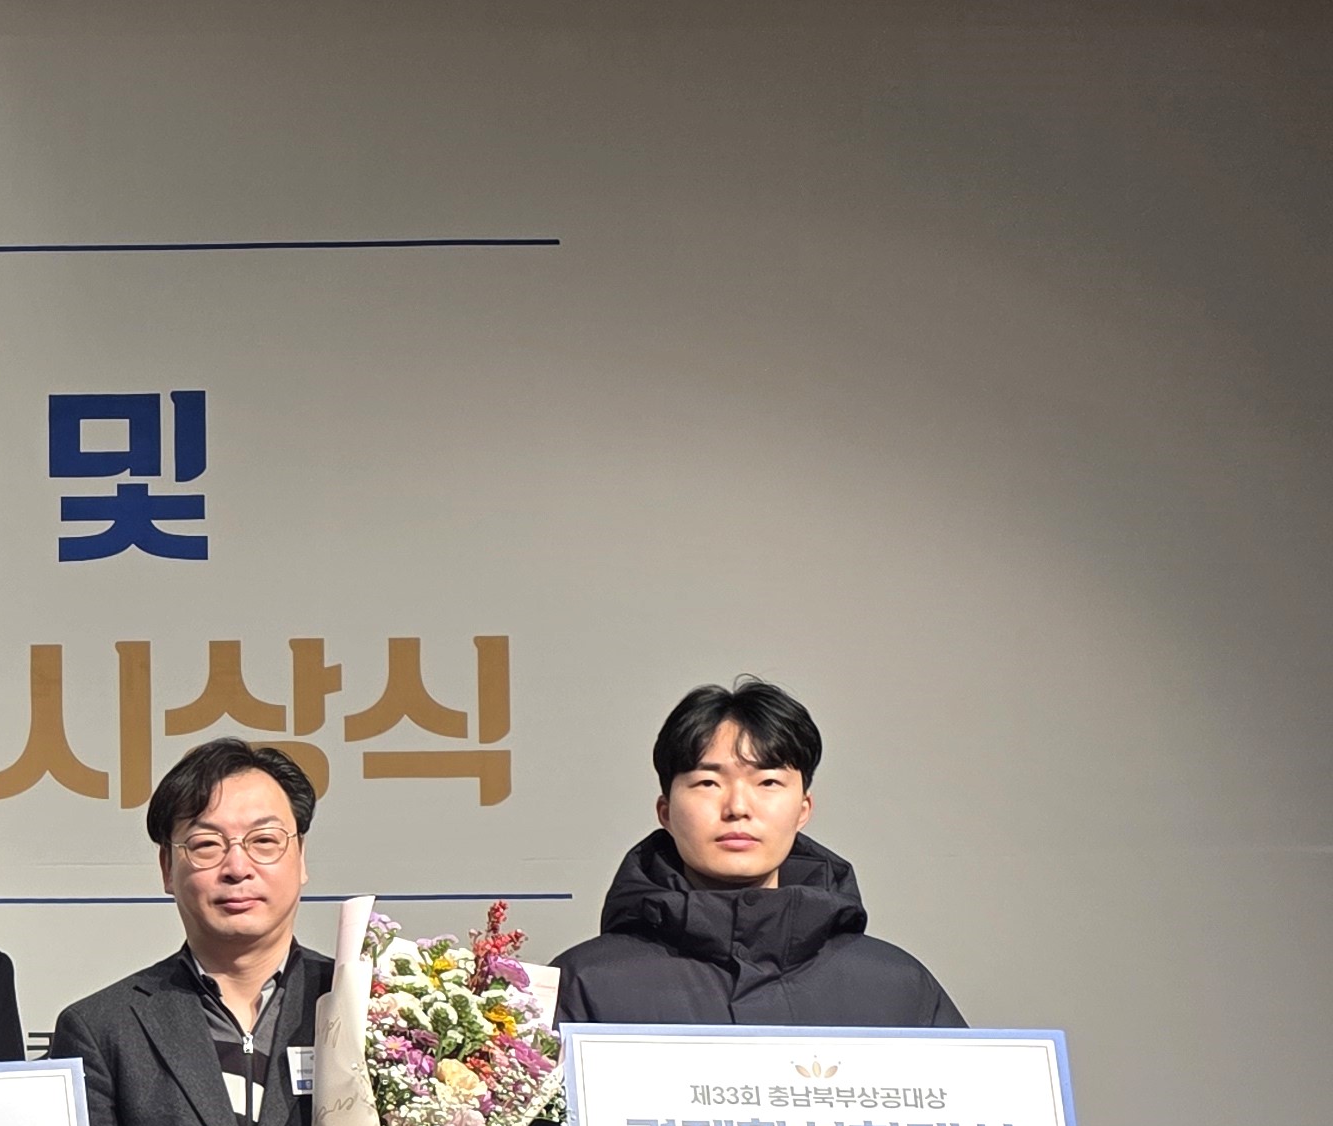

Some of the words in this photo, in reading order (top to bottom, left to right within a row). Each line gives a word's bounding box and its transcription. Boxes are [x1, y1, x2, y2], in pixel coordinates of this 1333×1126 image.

[49, 390, 208, 562] 및
[689, 1084, 761, 1107] 제33회
[768, 1085, 948, 1110] 충남북부상공대상
